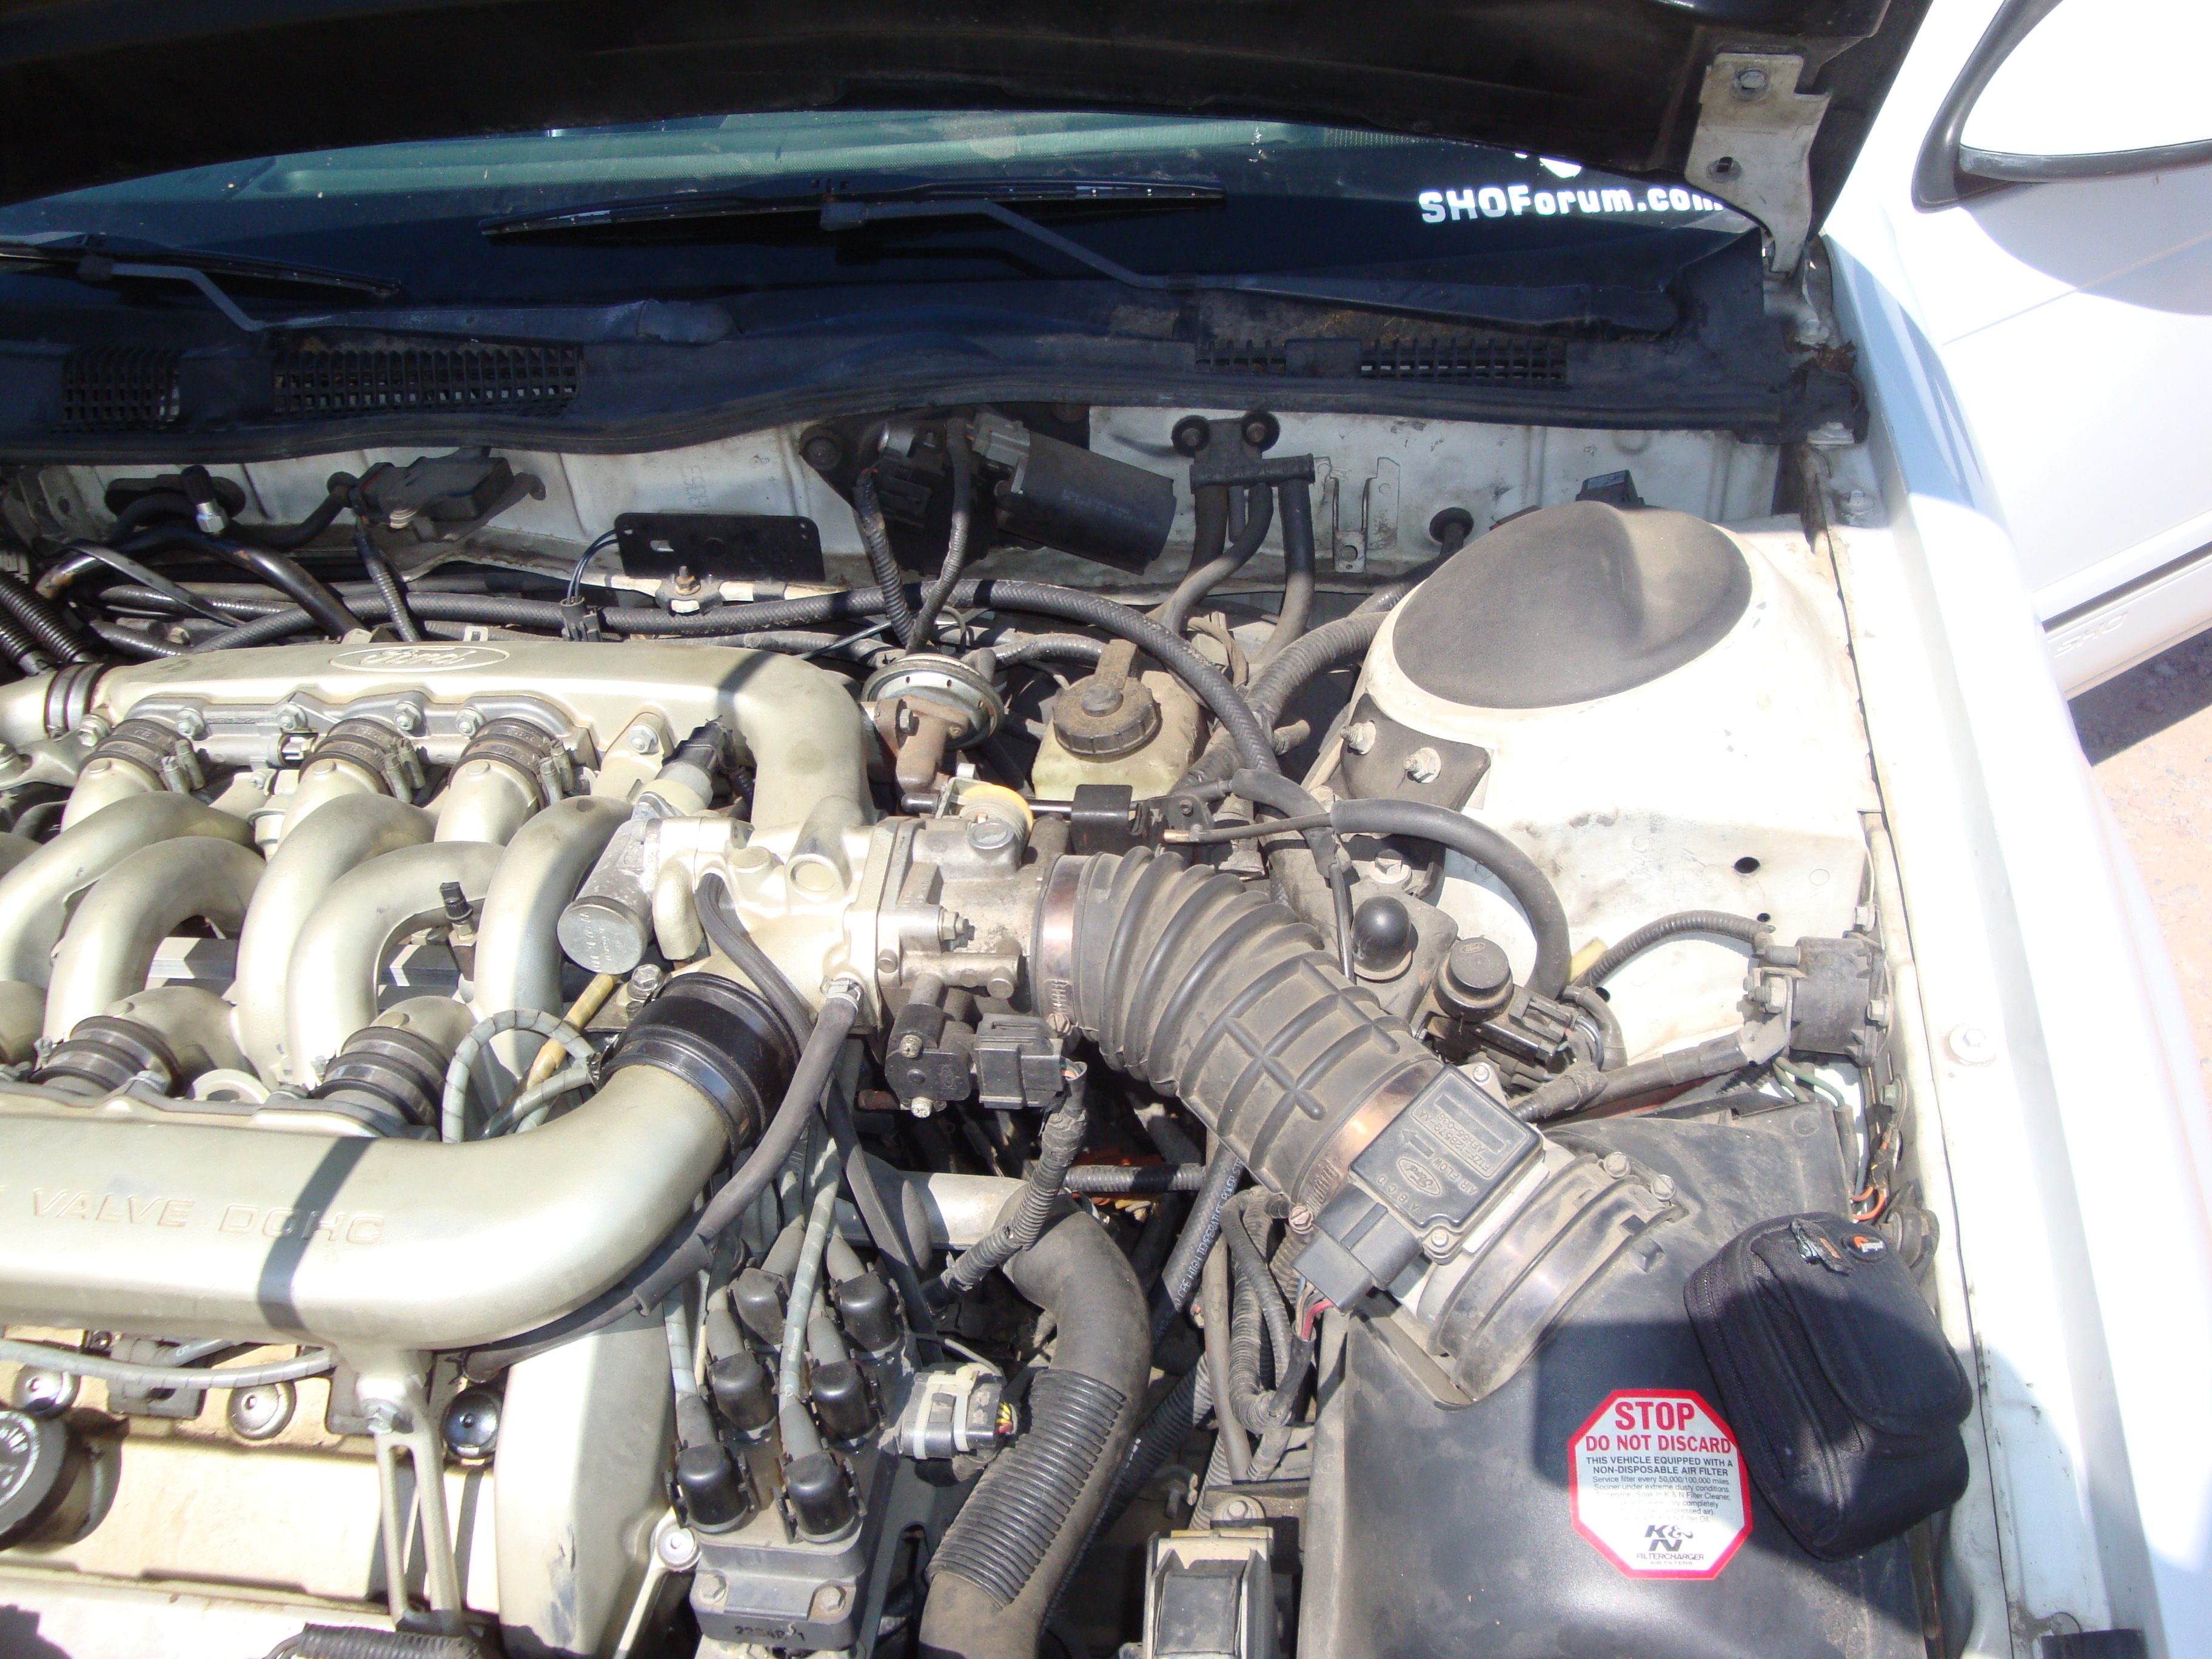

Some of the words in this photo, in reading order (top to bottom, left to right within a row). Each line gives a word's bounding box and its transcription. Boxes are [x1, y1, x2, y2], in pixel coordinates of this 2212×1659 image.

[1405, 1165, 1433, 1188] Ford
[1432, 1158, 1461, 1181] FLOW
[1460, 1181, 1478, 1195] AIR
[32, 1187, 195, 1228] VALVE
[219, 1202, 384, 1245] DOHC
[1188, 1257, 1202, 1280] HIGH
[1615, 1401, 1695, 1431] STOP
[1585, 1435, 1610, 1452] DO
[1617, 1435, 1652, 1451] NOT
[1658, 1435, 1732, 1454] DISCARD
[1593, 1466, 1678, 1474] NON-DISPOSABLE
[1610, 1456, 1652, 1464] VEHICLE
[1654, 1456, 1701, 1466] EQUIPPED
[1703, 1458, 1726, 1466] WITH
[1682, 1500, 1719, 1509] completely
